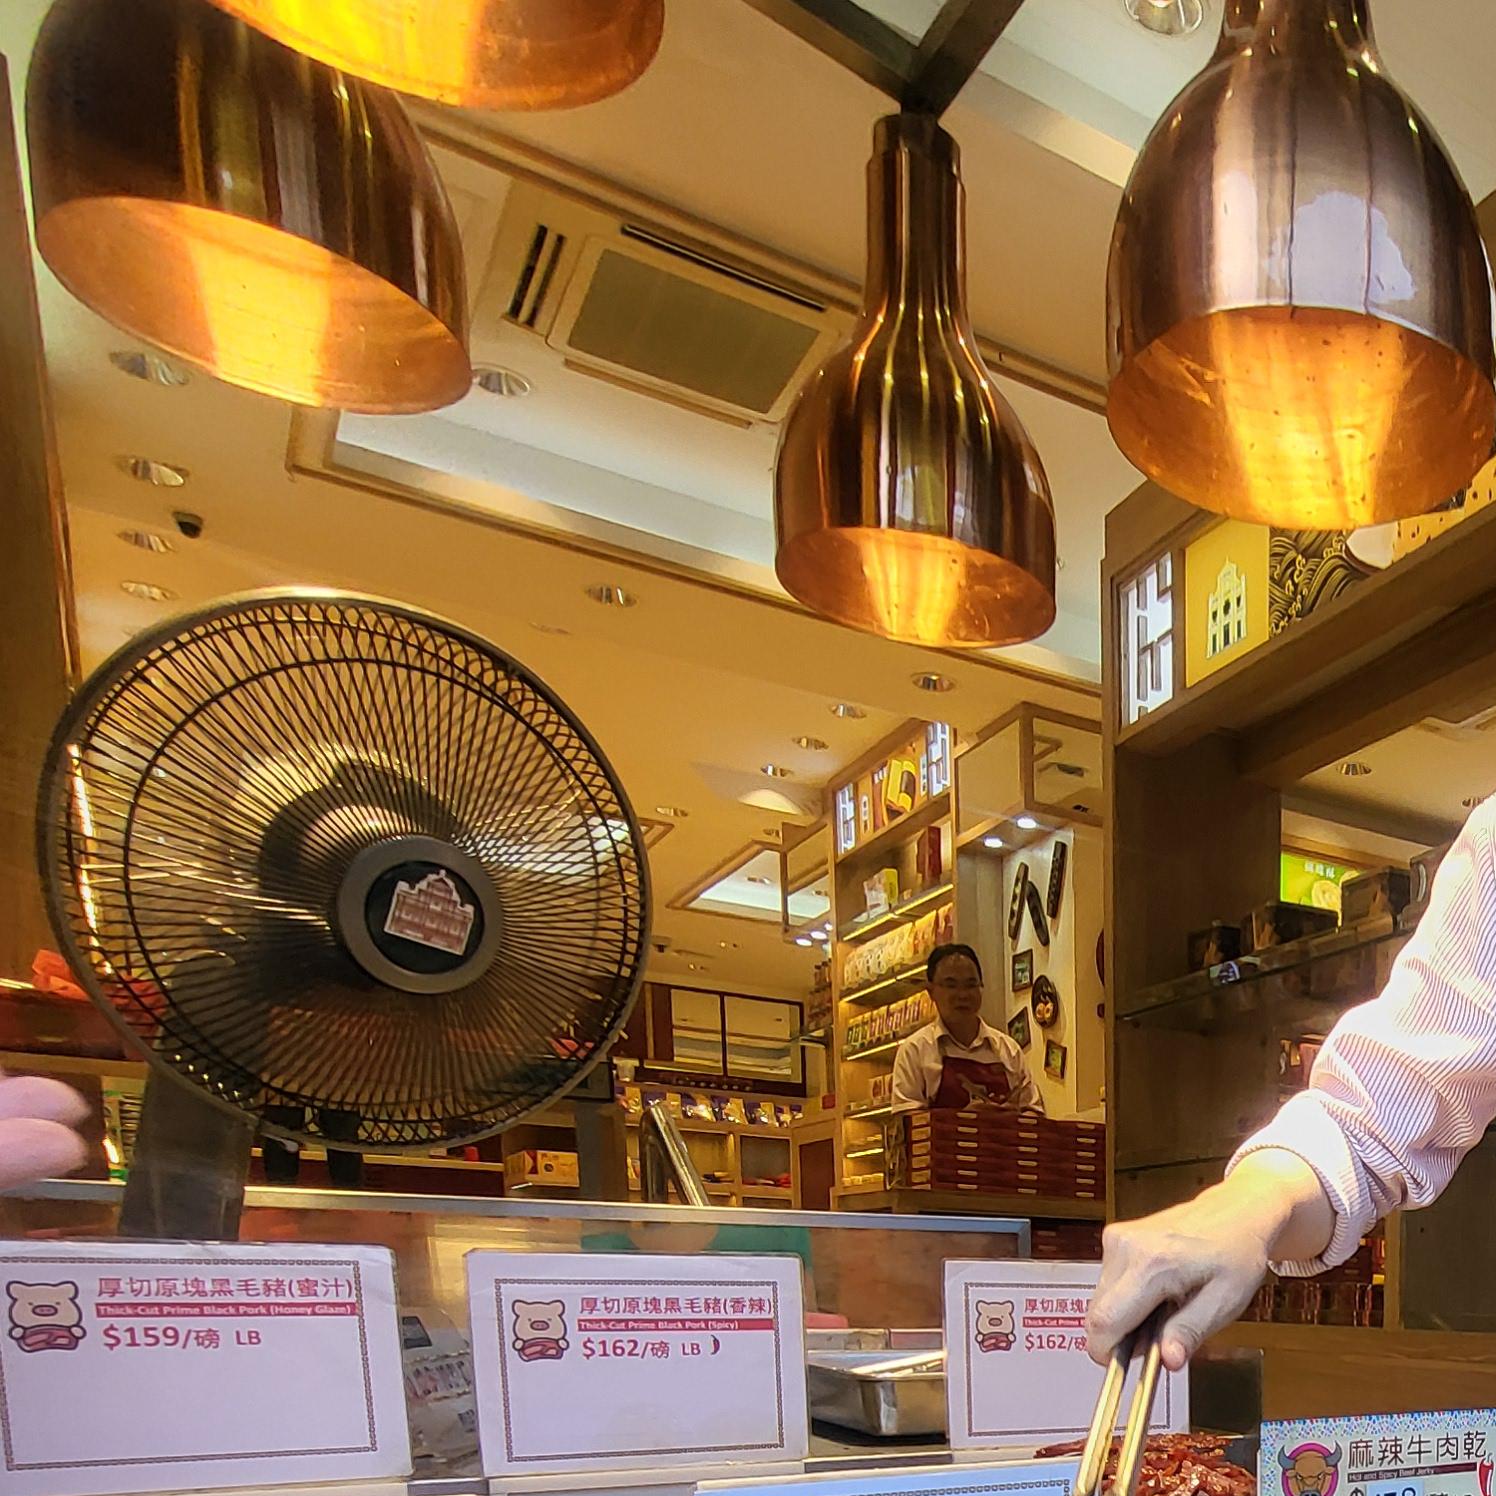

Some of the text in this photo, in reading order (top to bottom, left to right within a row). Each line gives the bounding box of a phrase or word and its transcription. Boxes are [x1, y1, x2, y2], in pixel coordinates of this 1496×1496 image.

[163, 1304, 200, 1316] Prime
[239, 1304, 267, 1315] Pork
[1024, 1298, 1092, 1313] 厚切原塊
[103, 1323, 262, 1351] $159/磅 LB
[582, 1337, 701, 1361] $162/磅 LB
[1348, 1430, 1487, 1470] 麻辣牛肉乾
